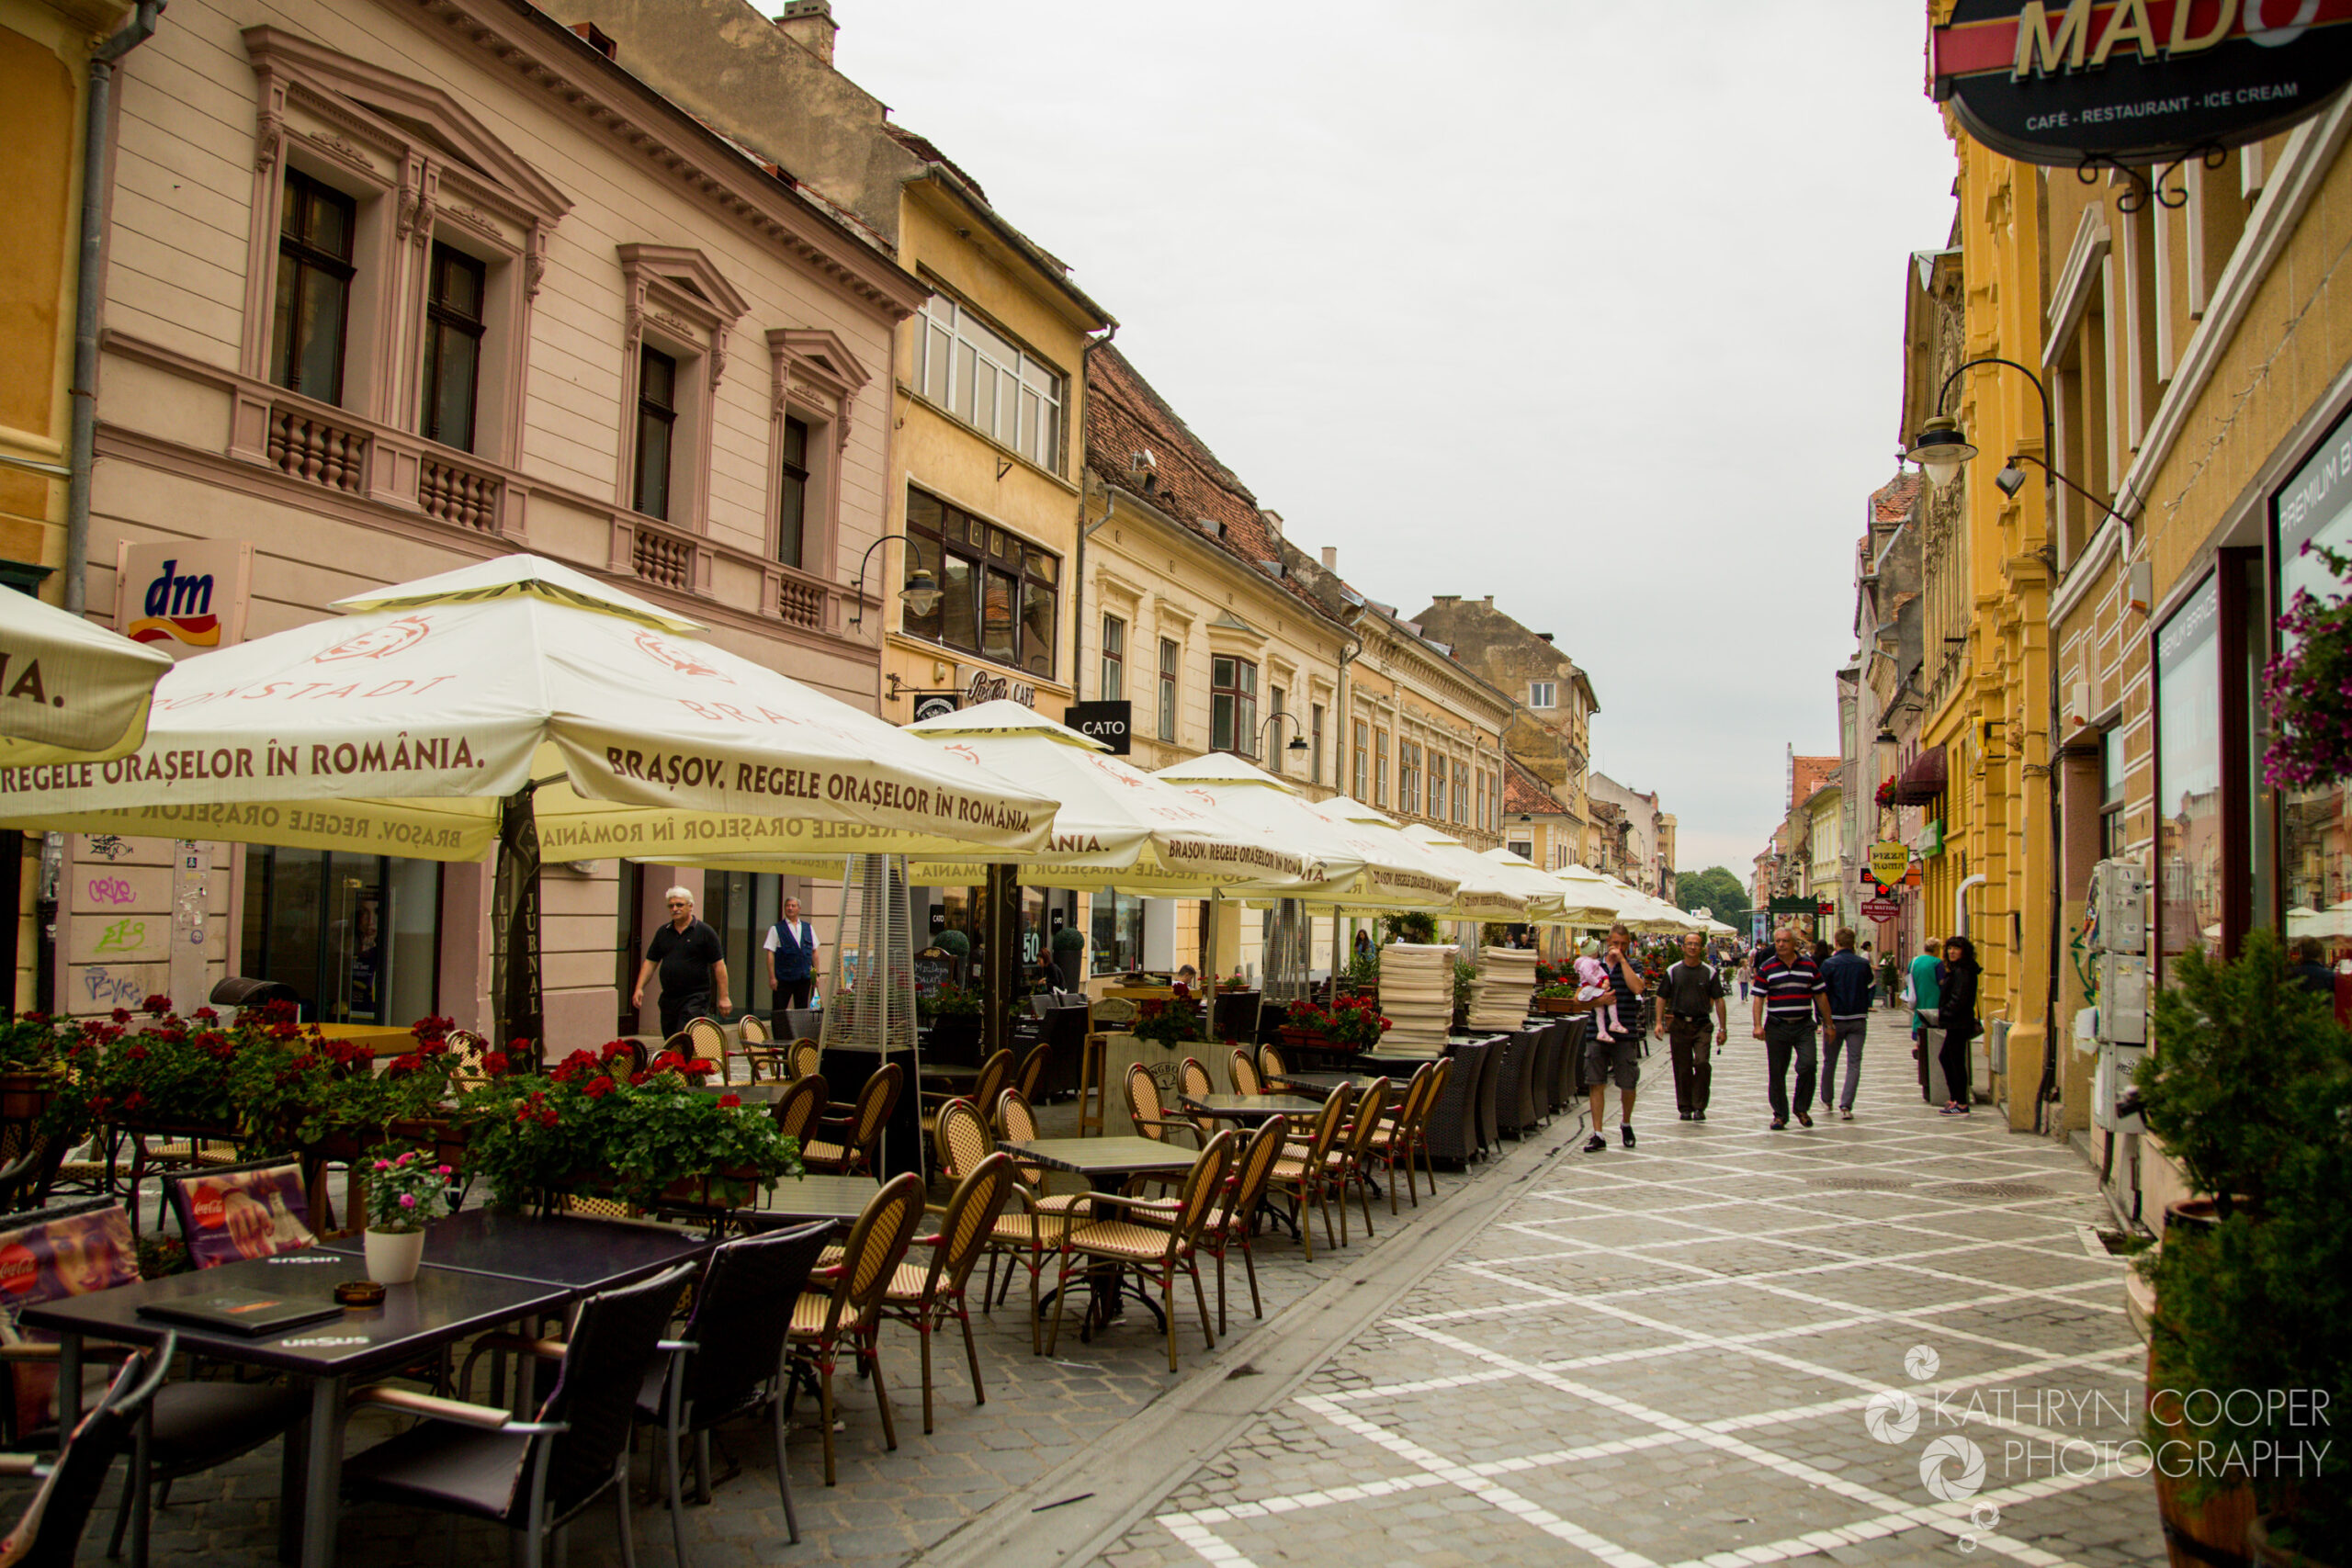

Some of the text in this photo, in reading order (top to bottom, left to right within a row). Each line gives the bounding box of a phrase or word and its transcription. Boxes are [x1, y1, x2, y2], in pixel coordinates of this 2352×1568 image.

[2010, 0, 2321, 84] MADO
[2026, 112, 2069, 131] CAFÉ
[2081, 98, 2191, 124] RESTAURANT
[2204, 92, 2233, 109] ICE
[2235, 83, 2299, 106] CREAM
[2280, 456, 2337, 542] PREMIUM
[144, 559, 214, 617] dm
[1012, 682, 1035, 708] CAFE
[1082, 721, 1125, 735] CATO
[103, 748, 254, 787] ORAȘELOR
[266, 739, 299, 776] ÎN
[311, 731, 485, 775] ROMÂNIA.
[606, 747, 1031, 833] BRAȘOV. REGELE ORAȘELOR ÎN ROMÂNIA.
[1209, 844, 1238, 862] REGELE
